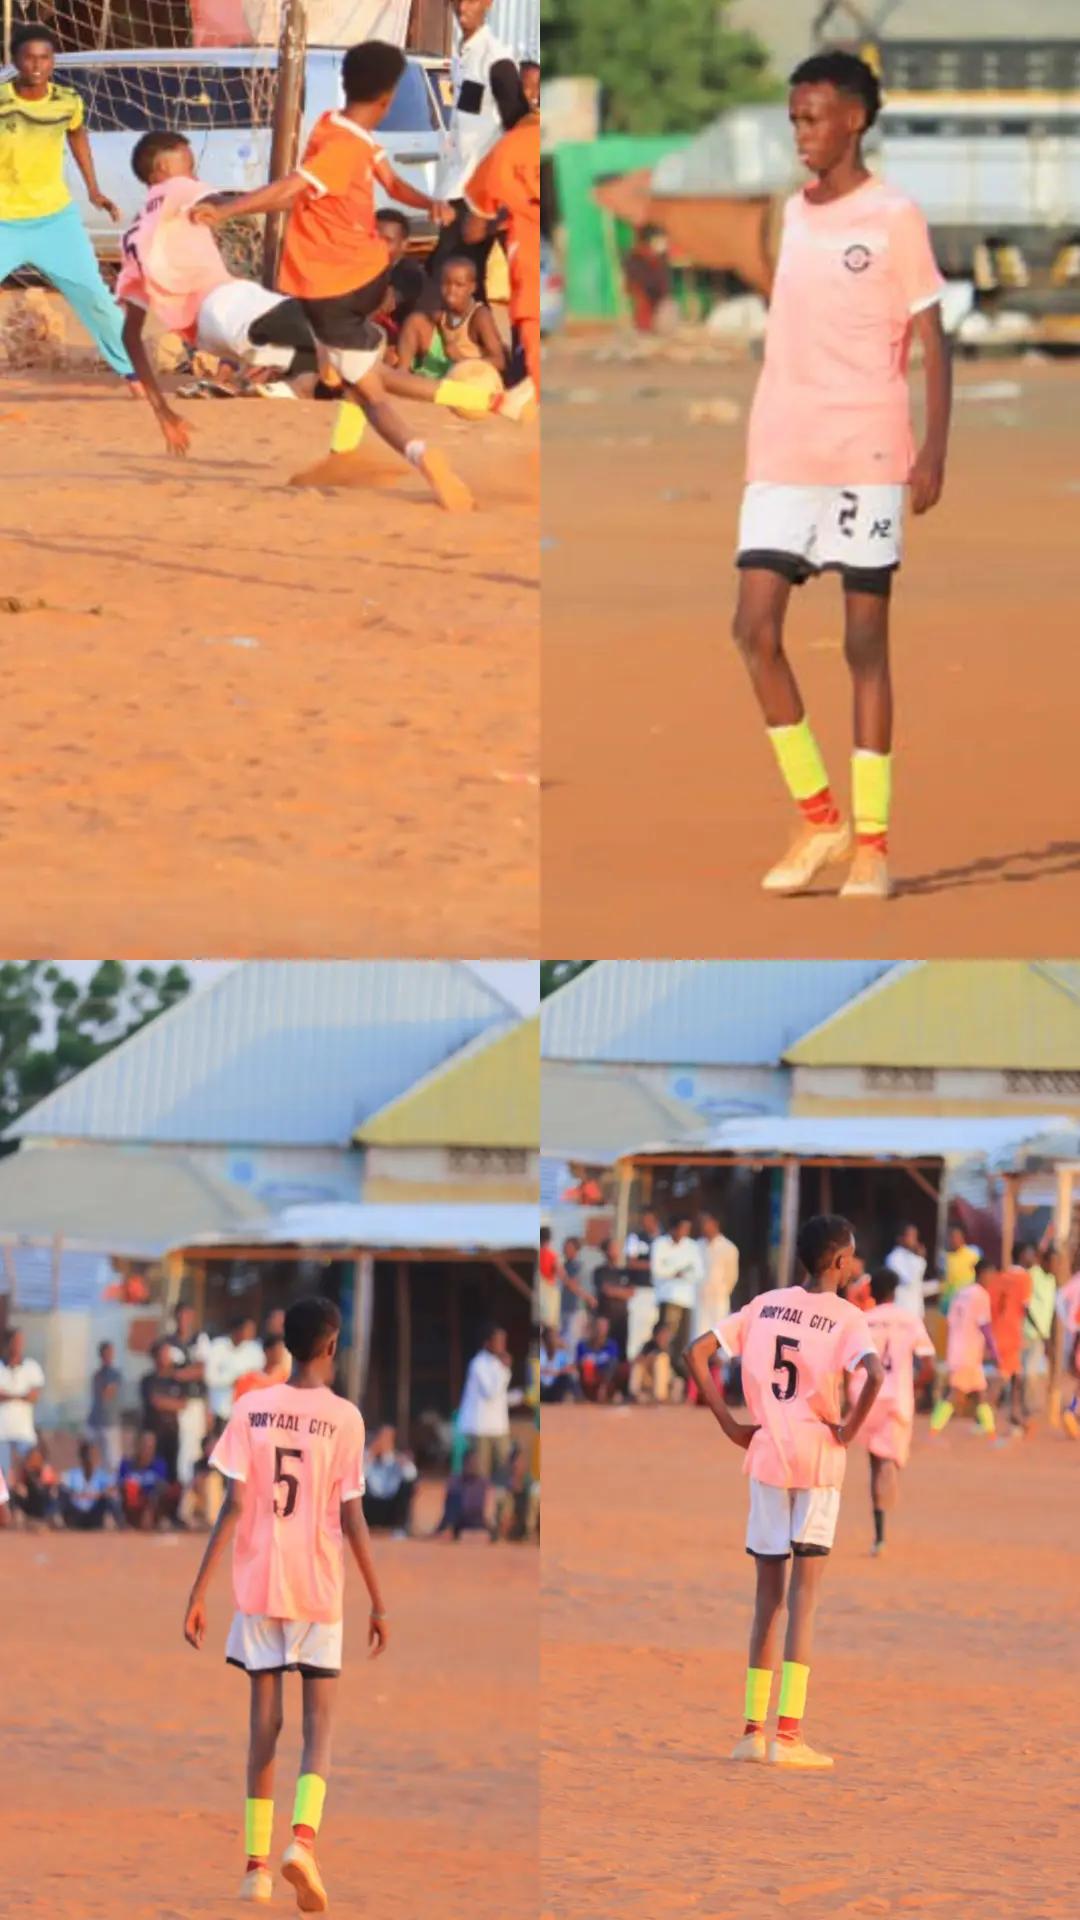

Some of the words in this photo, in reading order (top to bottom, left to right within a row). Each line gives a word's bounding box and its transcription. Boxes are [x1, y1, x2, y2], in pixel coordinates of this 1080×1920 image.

[760, 1305, 803, 1325] HORYAAL
[809, 1314, 837, 1334] CITY
[771, 1335, 801, 1403] 5
[309, 1418, 337, 1438] CITY
[272, 1446, 304, 1519] 5
